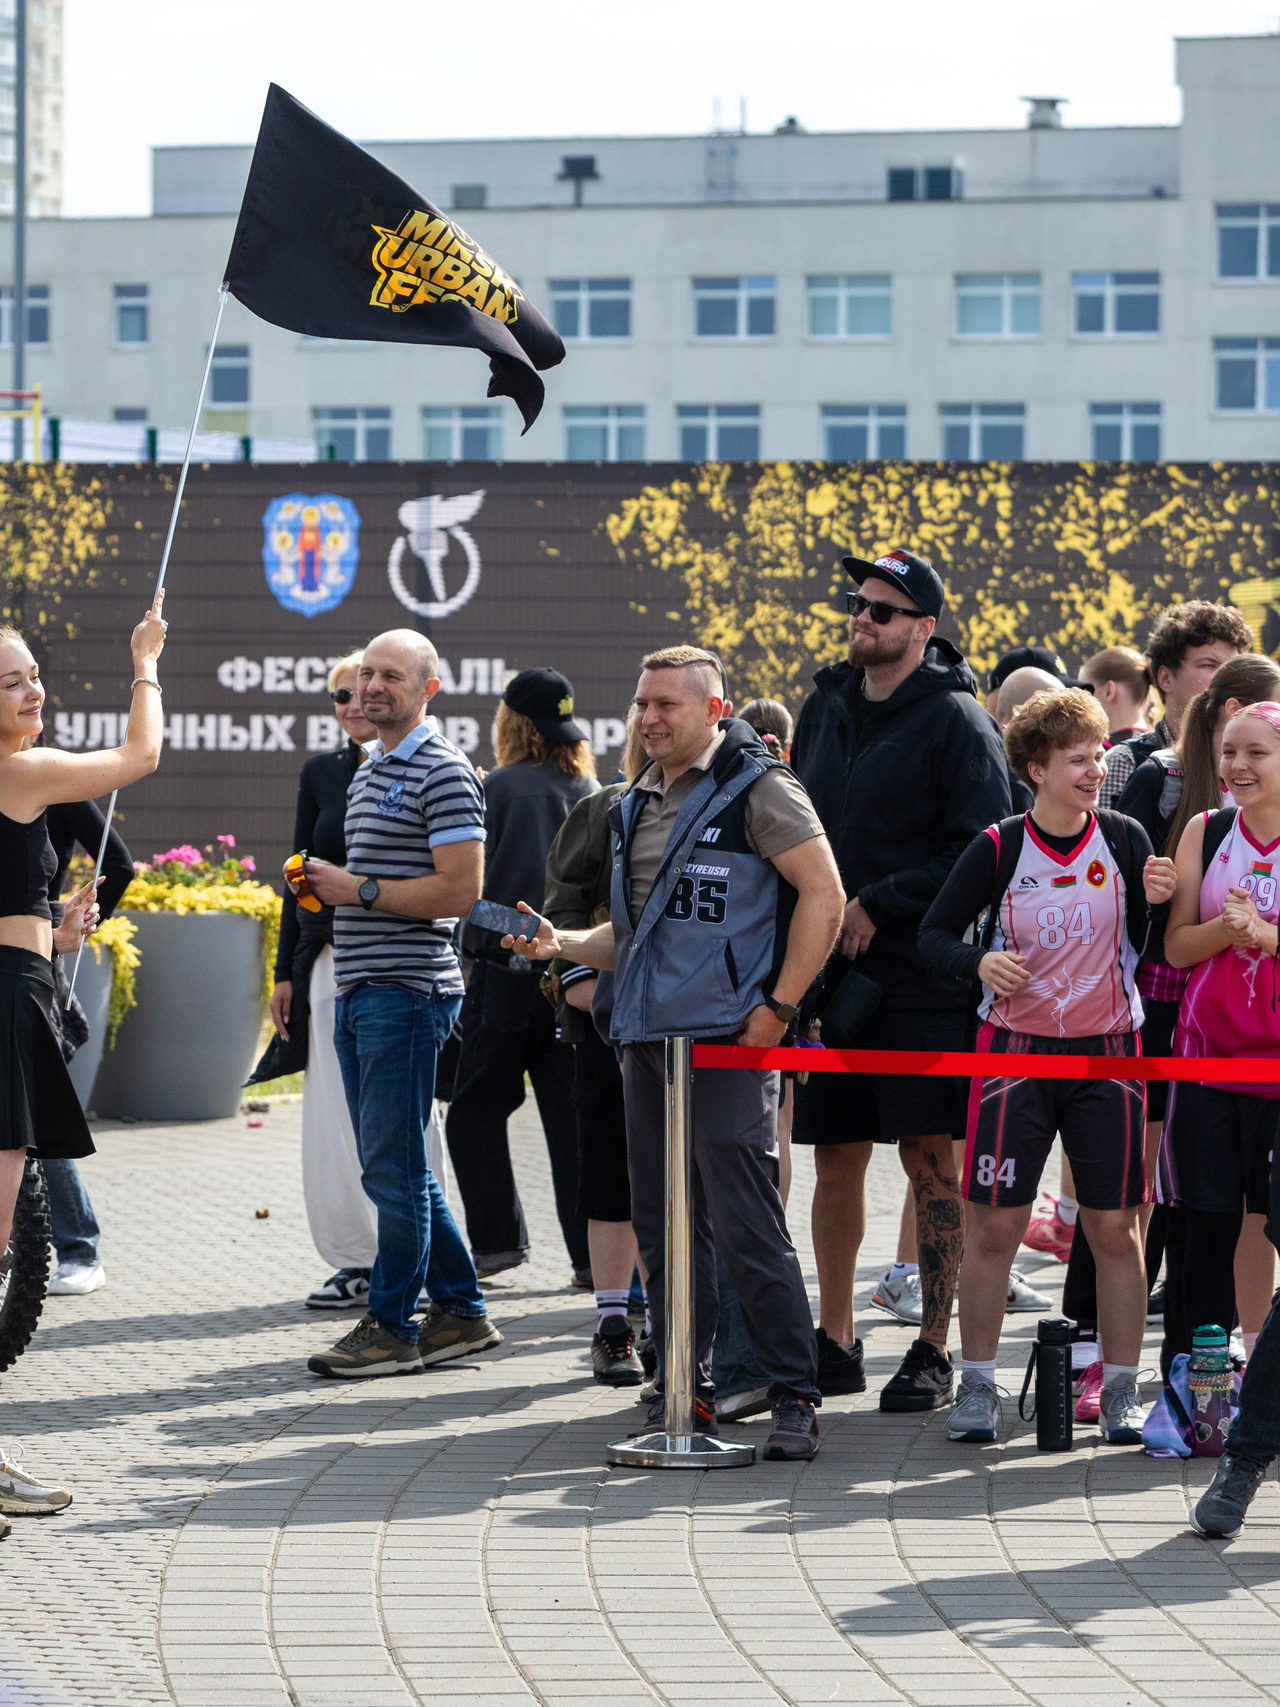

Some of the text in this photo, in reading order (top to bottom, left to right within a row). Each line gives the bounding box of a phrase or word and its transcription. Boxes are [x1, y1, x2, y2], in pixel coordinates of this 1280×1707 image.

[379, 233, 510, 324] URBAN
[400, 210, 517, 300] MINSK
[664, 875, 730, 925] 85
[1036, 902, 1095, 950] 84
[976, 1154, 1016, 1188] 84
